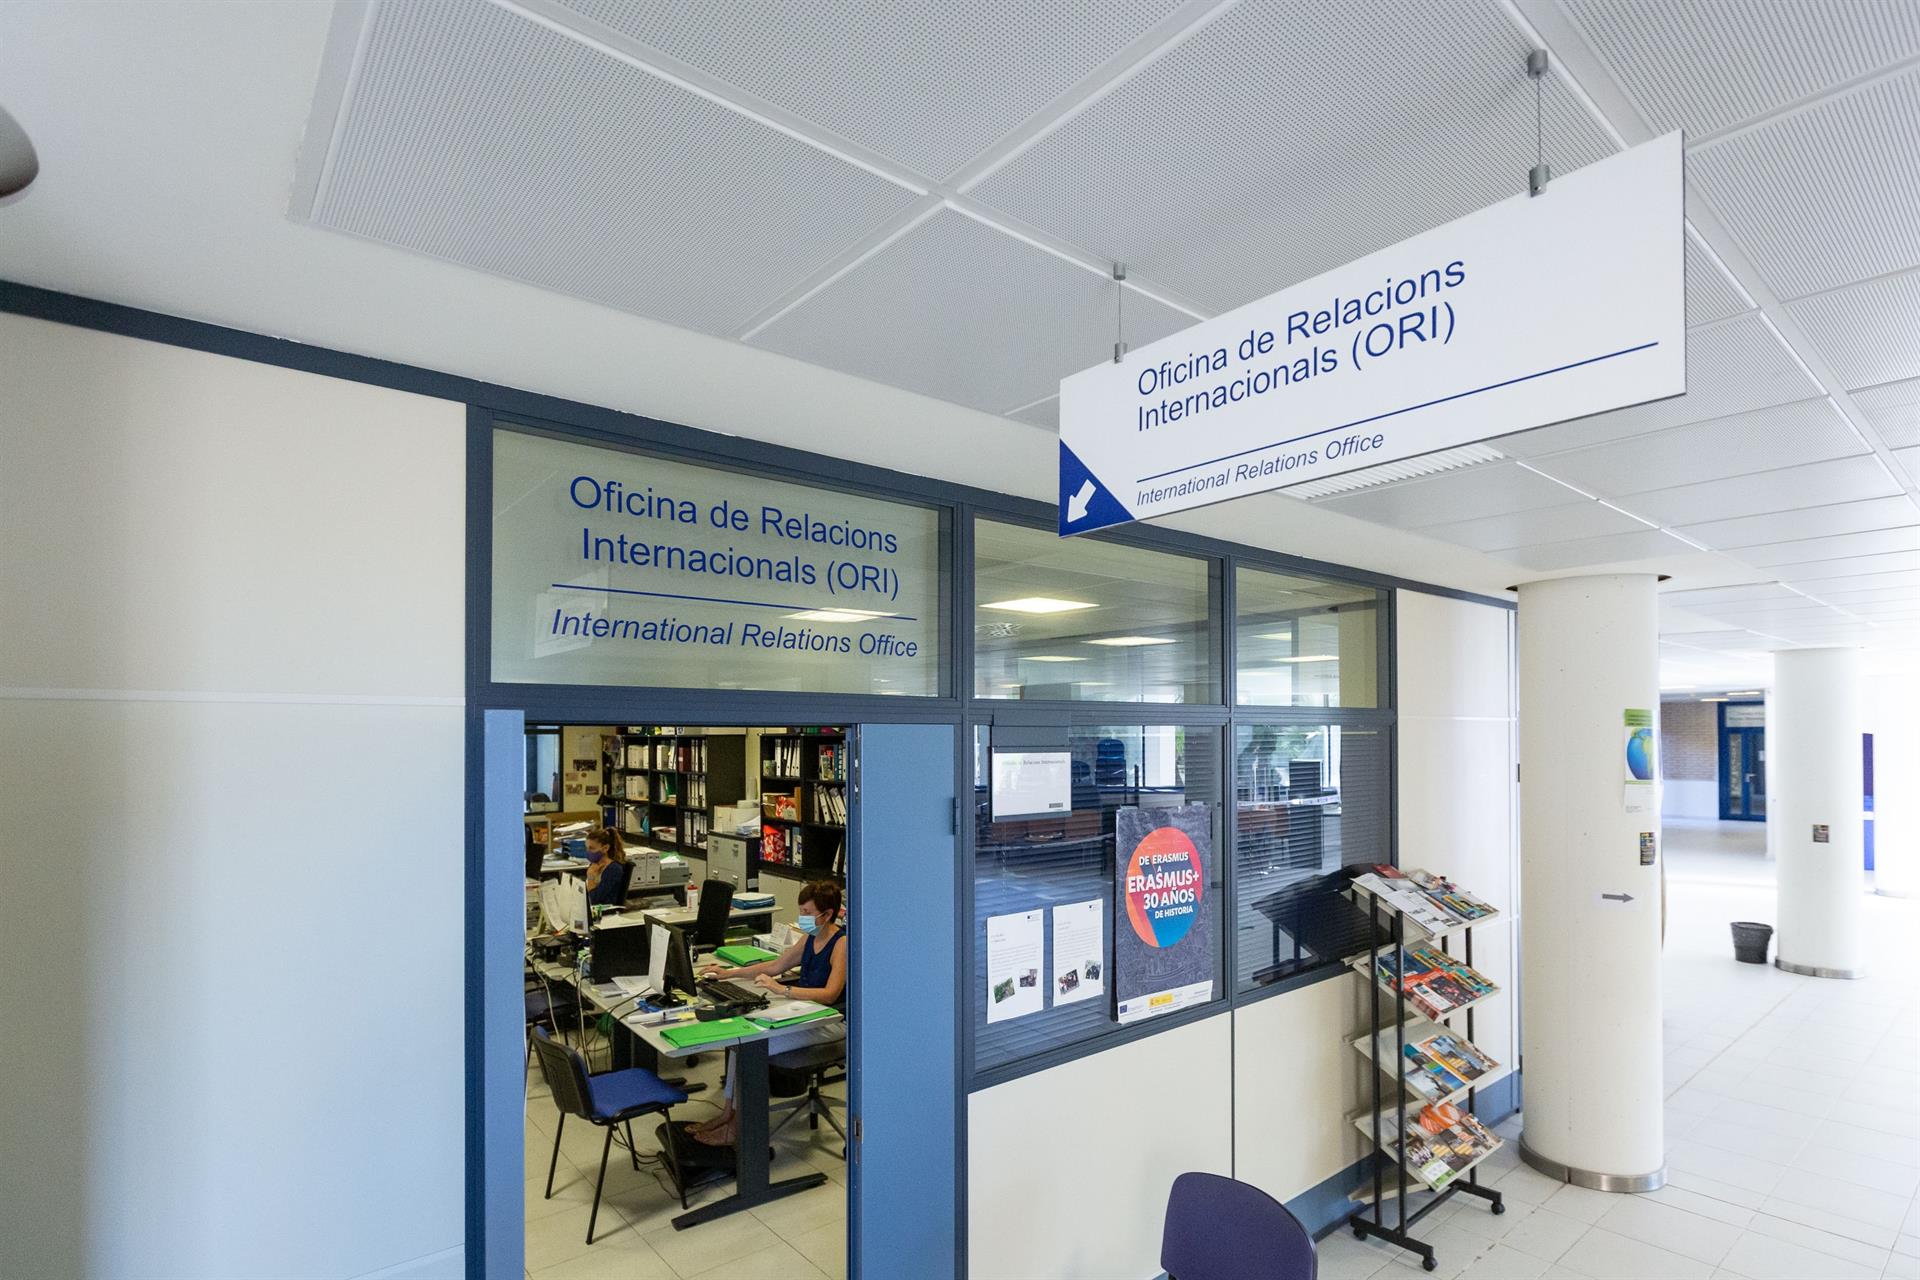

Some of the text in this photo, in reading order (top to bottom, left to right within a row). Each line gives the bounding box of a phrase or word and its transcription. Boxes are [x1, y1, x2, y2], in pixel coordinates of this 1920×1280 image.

[1138, 260, 1466, 397] Oficina de Relacions
[1137, 301, 1456, 432] Internacionals (ORI)
[1136, 430, 1385, 506] International Relations Office
[569, 475, 898, 554] Oficina de Relacions
[582, 527, 899, 601] Internacionals (ORI)
[551, 608, 919, 658] International Relations Office
[1128, 869, 1199, 894] ERASMUS+
[1138, 851, 1189, 866] DE ERASMUS
[1143, 886, 1195, 910] 30 AÑOS
[1154, 905, 1194, 919] DE HISTORIA
